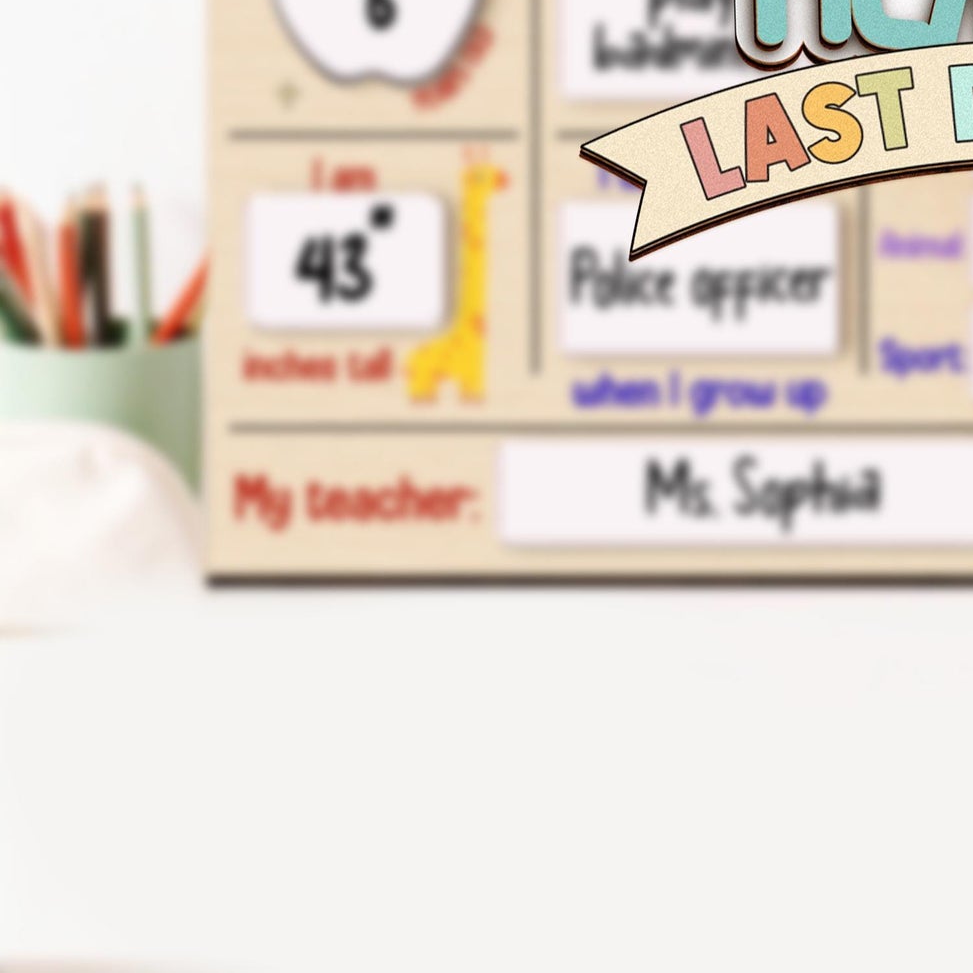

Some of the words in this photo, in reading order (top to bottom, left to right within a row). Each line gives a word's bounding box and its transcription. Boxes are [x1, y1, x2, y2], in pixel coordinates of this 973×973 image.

[678, 66, 916, 201] LAST
[293, 233, 375, 304] 43
[570, 370, 660, 410] when
[690, 376, 777, 418] grow
[786, 377, 828, 415] up
[232, 473, 293, 532] My
[734, 454, 882, 533] Sophia
